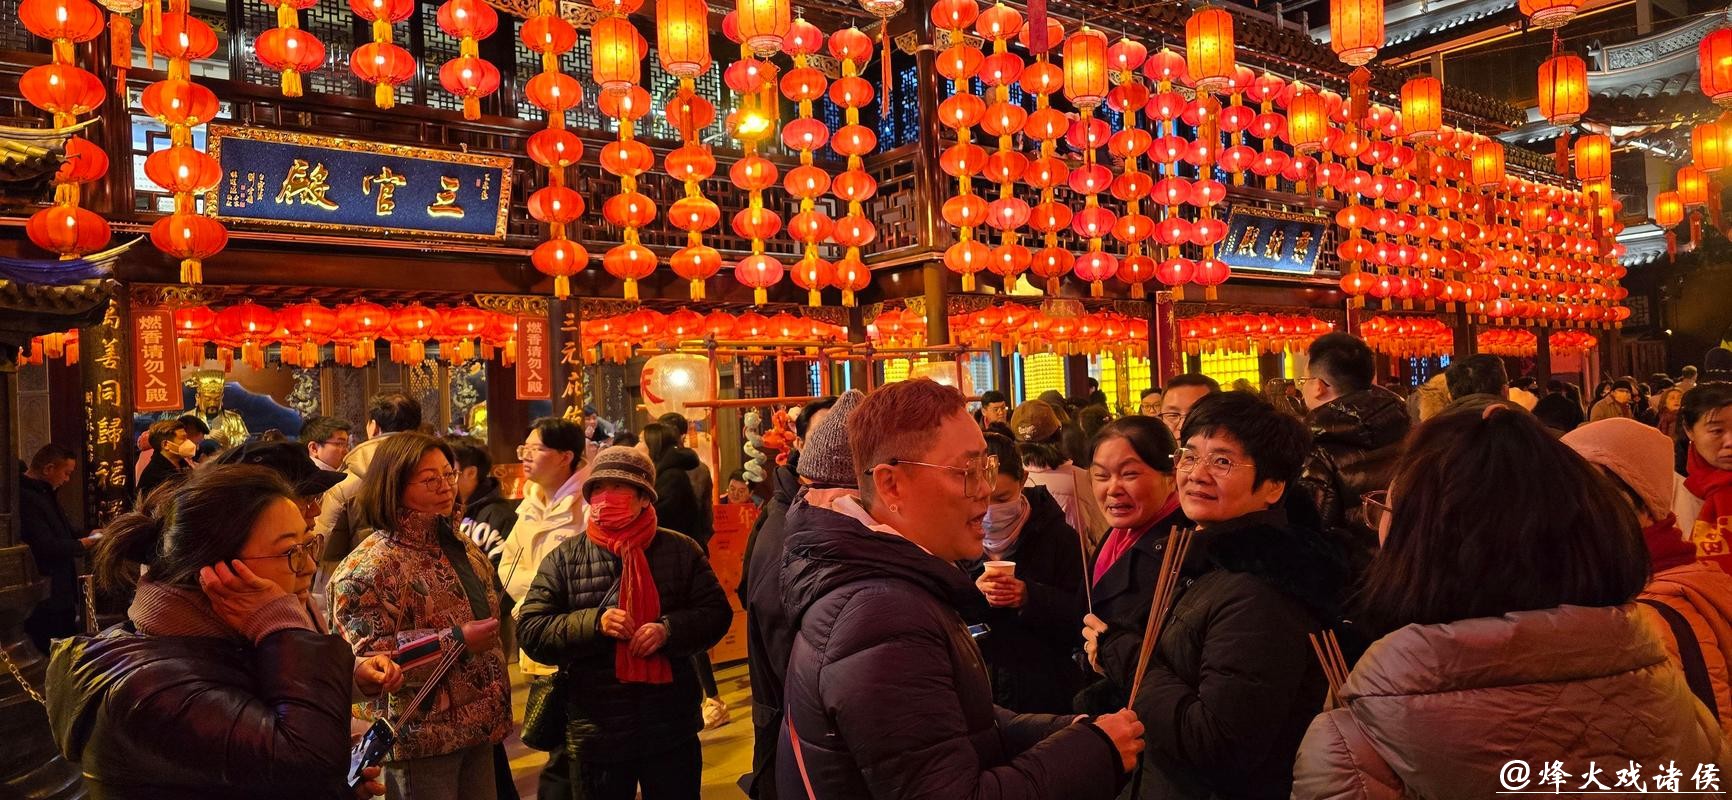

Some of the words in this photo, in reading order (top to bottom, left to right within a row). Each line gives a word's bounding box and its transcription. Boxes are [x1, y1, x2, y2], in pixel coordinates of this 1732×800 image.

[275, 159, 464, 218] 三官殿
[139, 315, 168, 403] 燃香请勿入殿
[526, 322, 543, 393] 燃香请勿入殿
